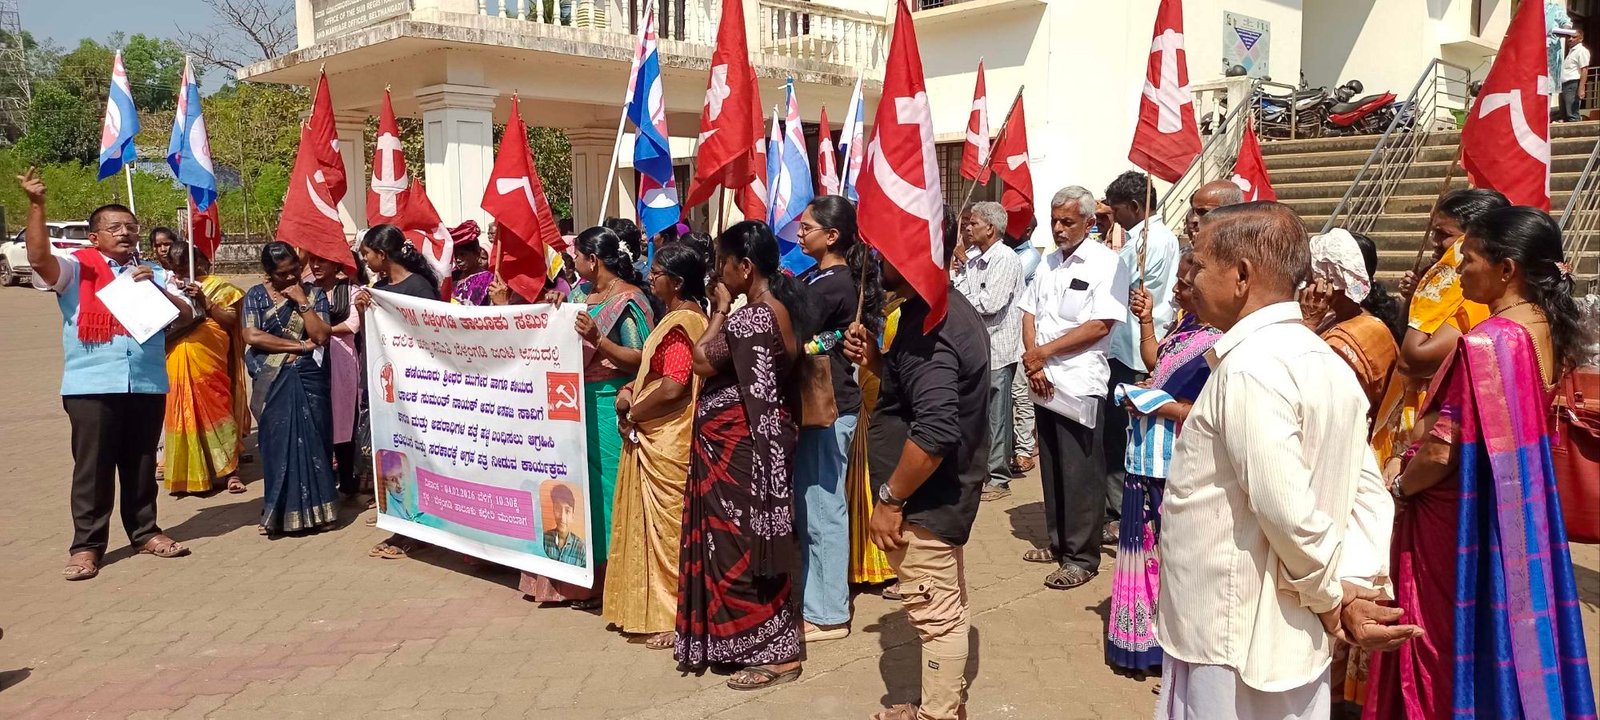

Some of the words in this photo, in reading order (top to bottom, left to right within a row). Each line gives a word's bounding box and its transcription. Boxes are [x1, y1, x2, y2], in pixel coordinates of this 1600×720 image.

[324, 14, 339, 26] OFFICE
[340, 11, 345, 20] OF
[459, 314, 509, 330] ತಾಲೂಕು
[514, 312, 548, 330] ಸಮಿತಿ
[393, 334, 414, 347] ದಲಿತ
[490, 377, 508, 390] ಹಾಗೂ
[518, 406, 544, 420] ಸಾವಿಗೆ
[491, 455, 517, 470] ನೀಡುವ
[521, 460, 567, 479] ಕಾರ್ಯಕ್ರಮ
